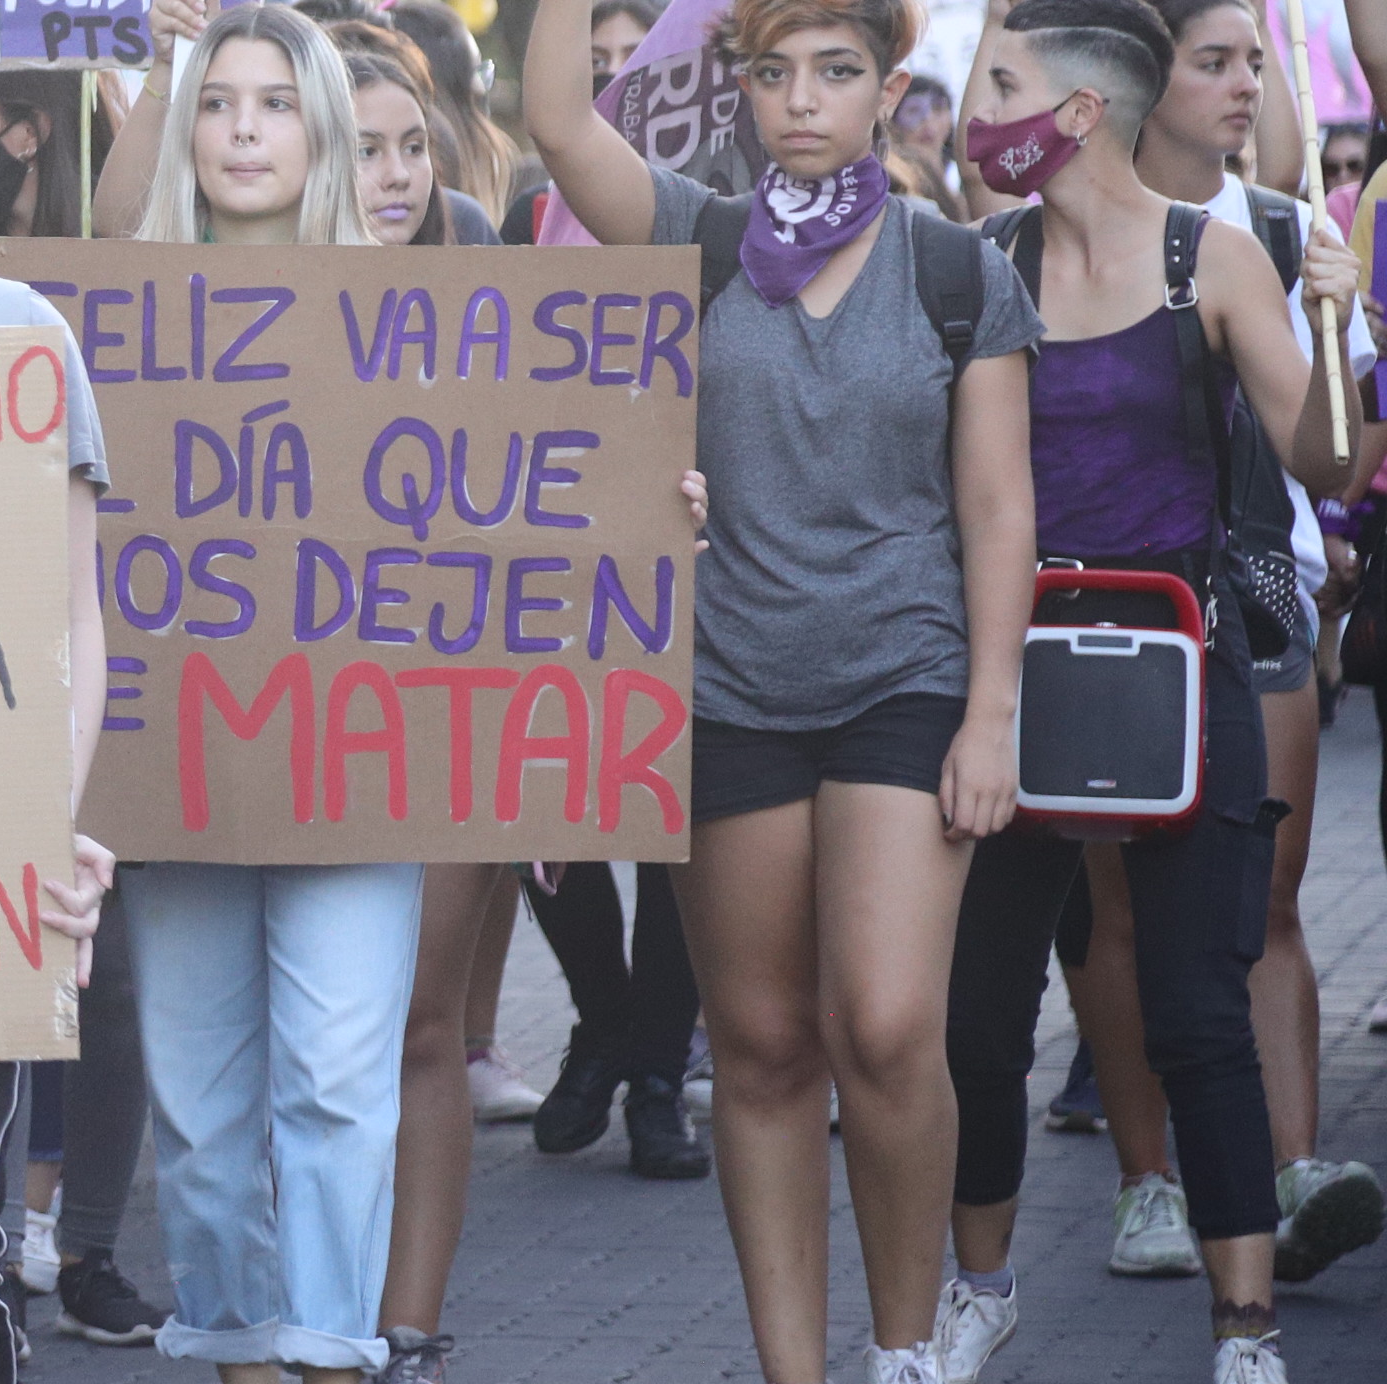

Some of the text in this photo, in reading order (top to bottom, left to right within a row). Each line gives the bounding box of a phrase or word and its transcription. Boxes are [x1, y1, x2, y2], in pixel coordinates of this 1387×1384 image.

[42, 11, 149, 65] PTS
[339, 286, 438, 383] VA
[456, 286, 512, 382] A
[528, 289, 696, 398] SER
[174, 399, 600, 541] DÍA QUE
[293, 537, 675, 660] DEJEN
[177, 651, 687, 835] MATAR
